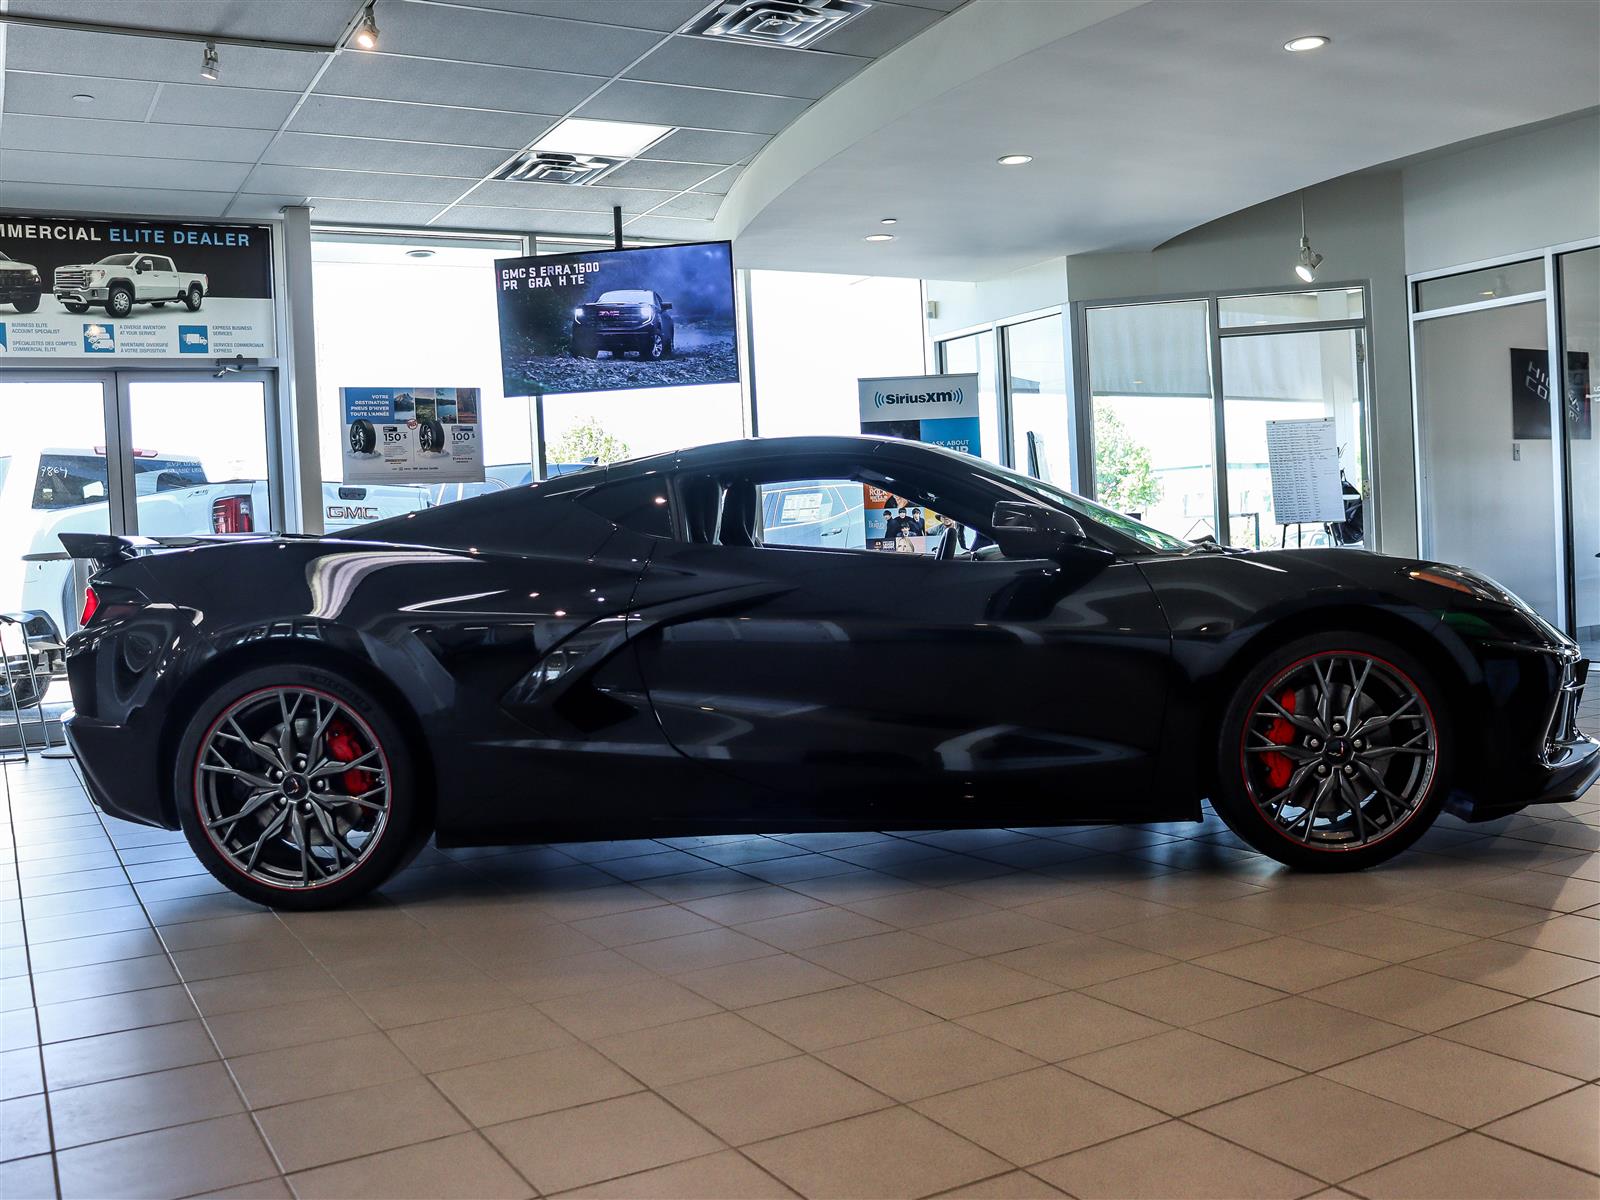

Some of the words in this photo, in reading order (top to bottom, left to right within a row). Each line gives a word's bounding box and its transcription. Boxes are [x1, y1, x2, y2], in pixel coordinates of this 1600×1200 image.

[109, 228, 165, 244] ELITE
[173, 231, 250, 247] DEALER
[502, 268, 526, 280] GMC
[573, 262, 600, 274] 1500
[383, 433, 402, 442] 150
[452, 432, 470, 441] 100
[326, 506, 379, 520] GMC
